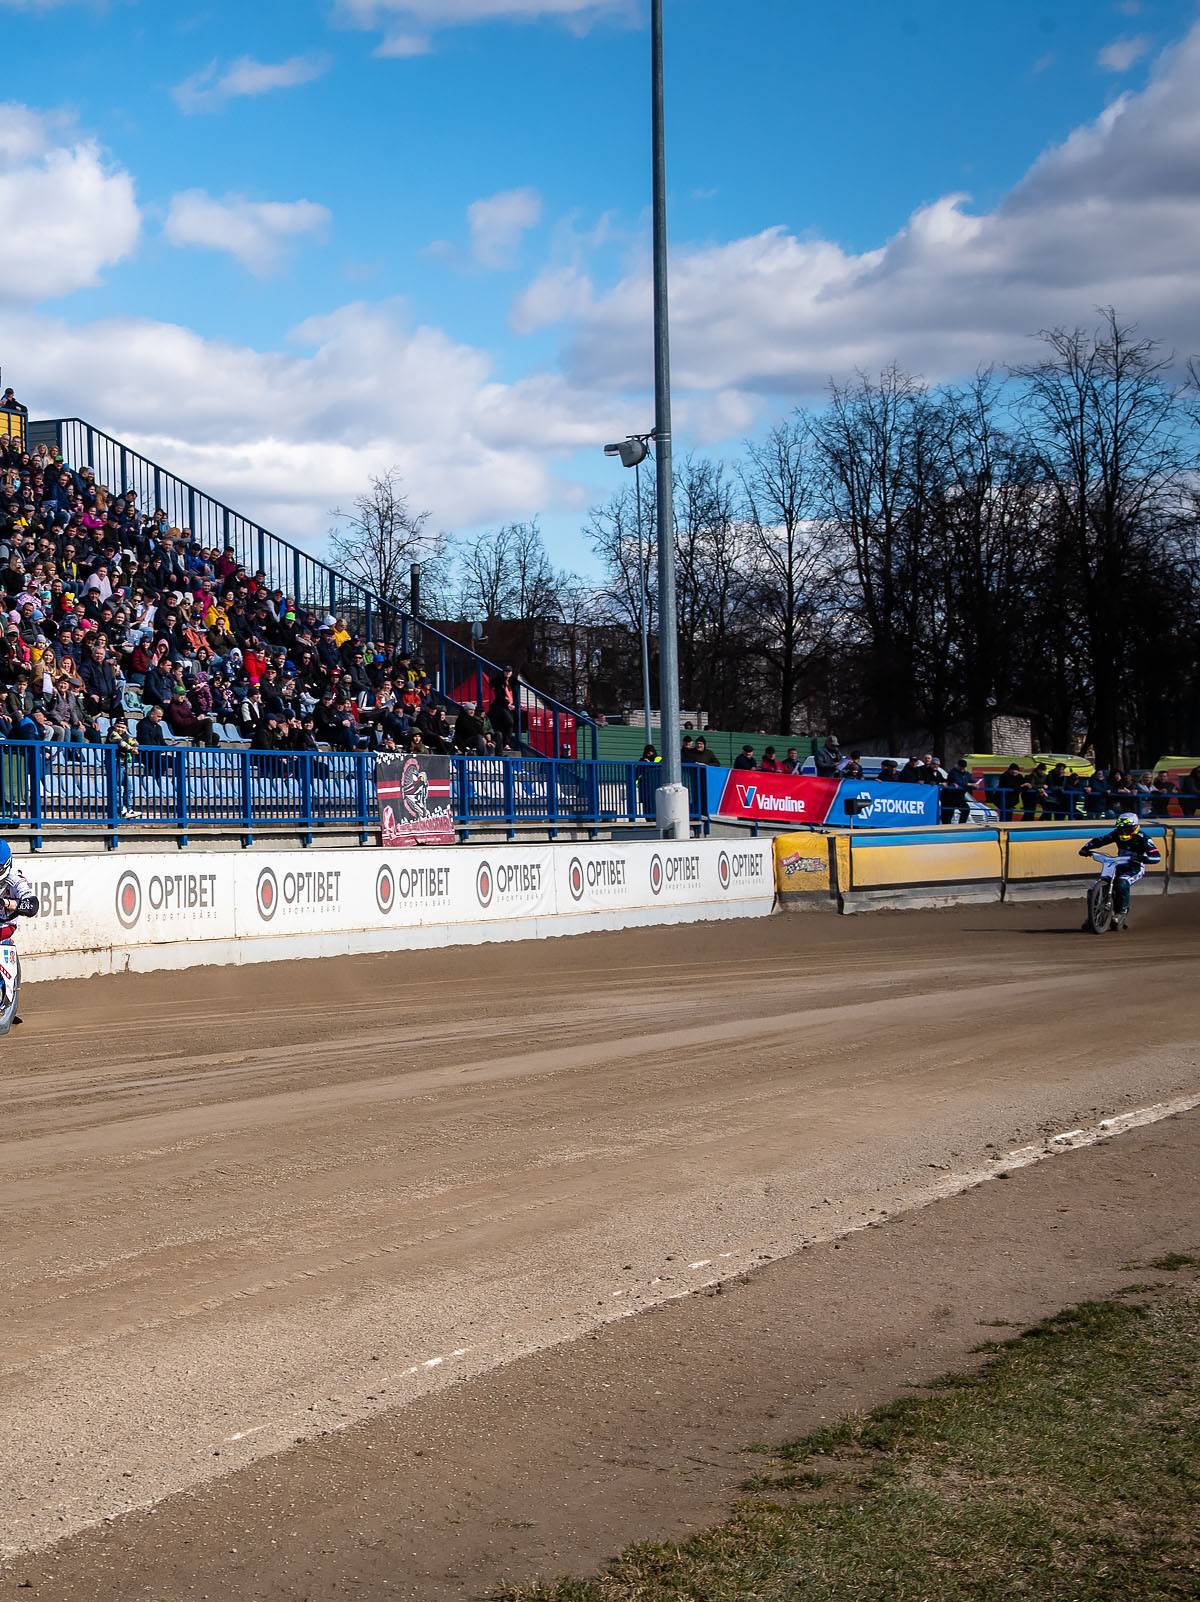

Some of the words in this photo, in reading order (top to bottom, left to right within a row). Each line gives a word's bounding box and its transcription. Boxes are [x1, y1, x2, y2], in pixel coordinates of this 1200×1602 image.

[756, 793, 806, 812] Valvoline
[874, 798, 925, 815] STOKKER
[497, 864, 541, 892] OPTIBET
[587, 860, 626, 886] OPTIBET
[665, 856, 700, 881] OPTIBET
[732, 854, 763, 877] OPTIBET
[149, 874, 217, 910] OPTIBET
[283, 871, 341, 904] OPTIBET
[399, 868, 450, 898] OPTIBET
